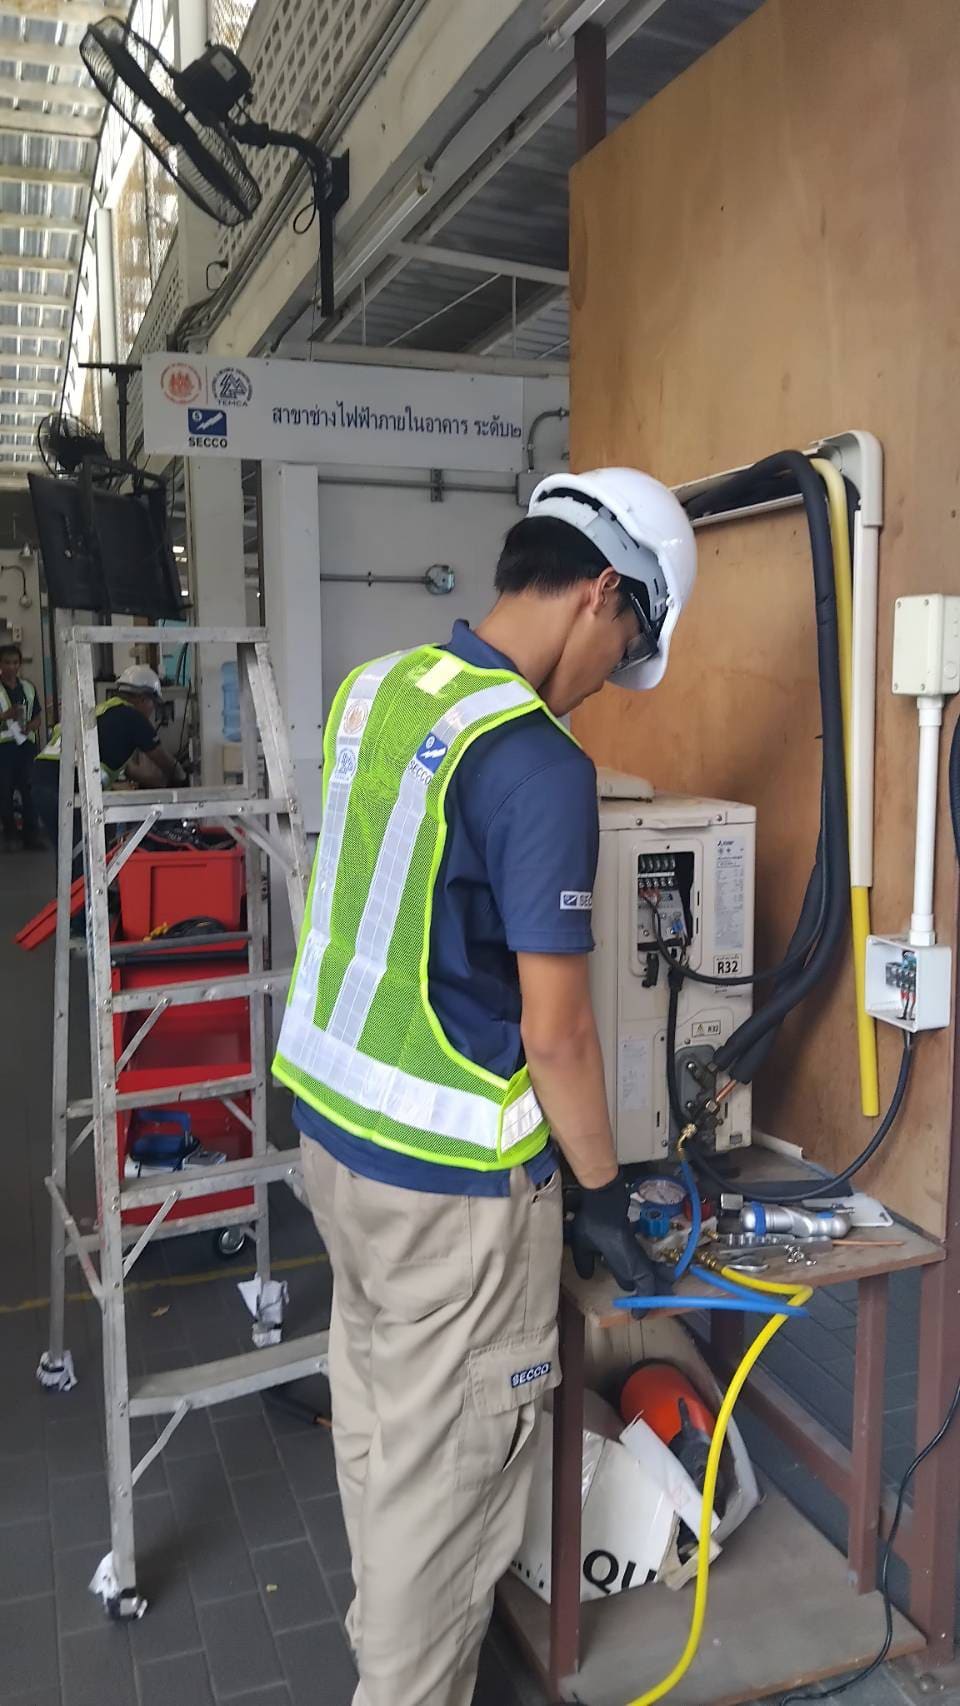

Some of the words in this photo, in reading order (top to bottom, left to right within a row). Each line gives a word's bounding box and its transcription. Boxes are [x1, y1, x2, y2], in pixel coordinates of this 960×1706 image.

[218, 398, 249, 408] TEMCA
[272, 400, 468, 435] สาขาช่างไฟฟ้าภายในอาคาร
[188, 437, 228, 449] SECCO
[407, 760, 433, 786] SECCO
[717, 960, 739, 975] R32
[512, 1363, 550, 1386] SECCO
